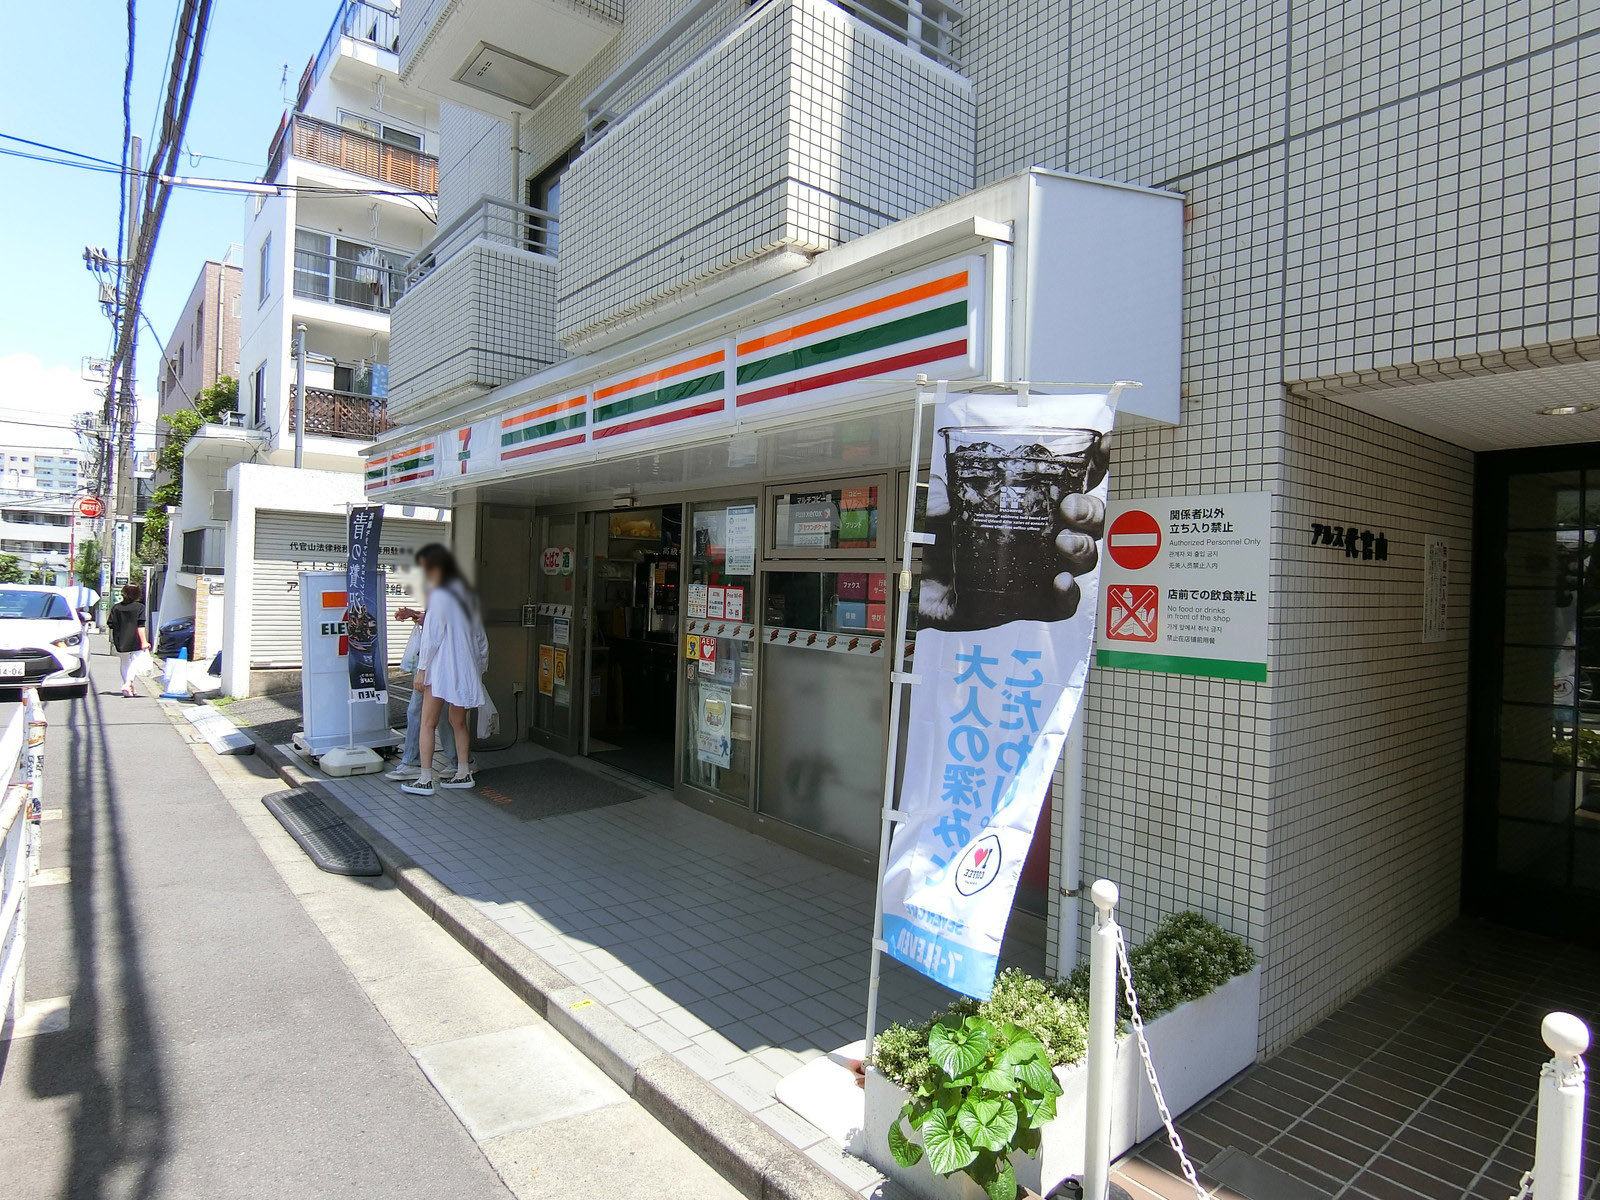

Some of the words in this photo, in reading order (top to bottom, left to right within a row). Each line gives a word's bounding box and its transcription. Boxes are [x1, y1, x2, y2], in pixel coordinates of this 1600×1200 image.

[1169, 507, 1225, 521] 関係者以外
[1169, 522, 1234, 534] 立ち入り禁止
[1206, 538, 1242, 546] Personnel
[1243, 537, 1261, 546] Only
[1311, 523, 1388, 561] アルス代官山
[543, 551, 560, 568] たばこ
[562, 551, 570, 568] 酒
[292, 560, 335, 571] T.I.S
[1167, 589, 1257, 602] 店前での飲食禁止
[1204, 606, 1226, 614] drinks
[1191, 613, 1199, 621] of
[701, 637, 715, 646] AED
